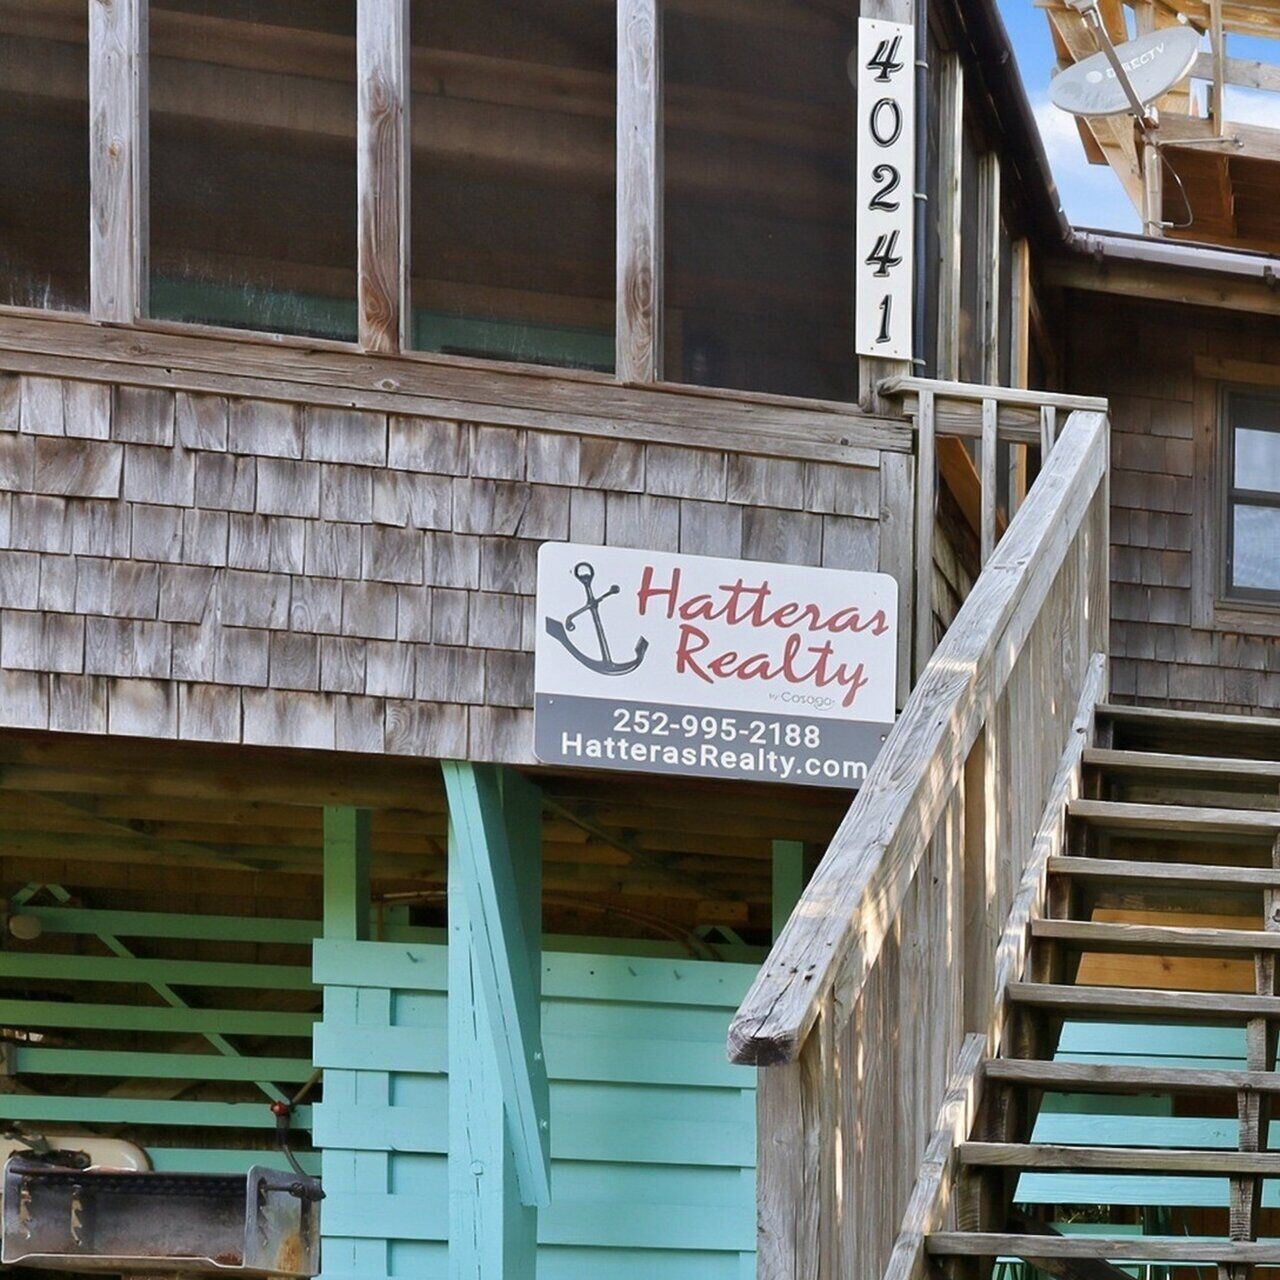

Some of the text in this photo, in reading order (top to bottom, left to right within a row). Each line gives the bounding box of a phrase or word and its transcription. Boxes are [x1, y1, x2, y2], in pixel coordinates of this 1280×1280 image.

[865, 35, 904, 343] 40241
[637, 566, 889, 637] Hatteras
[676, 624, 869, 708] Realty
[561, 732, 869, 780] HatterasRealty.com
[612, 708, 821, 748] 252-995-2188
